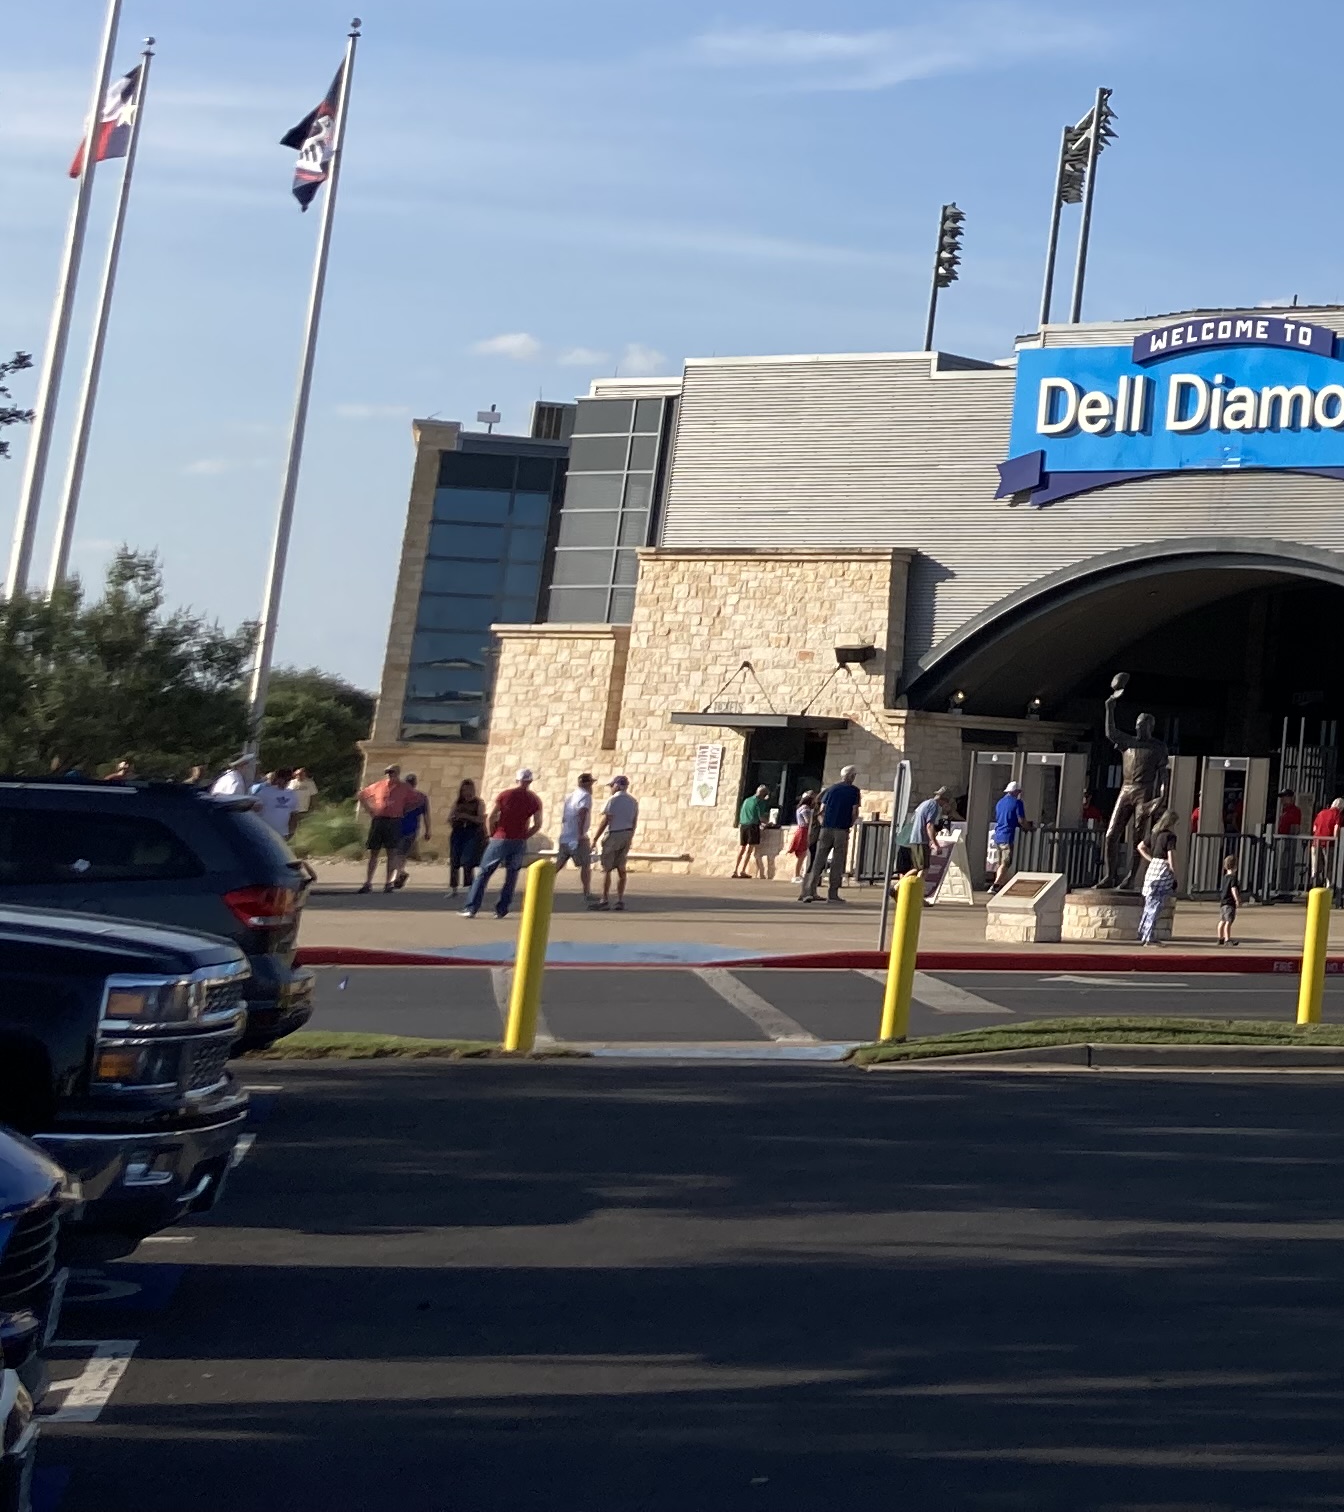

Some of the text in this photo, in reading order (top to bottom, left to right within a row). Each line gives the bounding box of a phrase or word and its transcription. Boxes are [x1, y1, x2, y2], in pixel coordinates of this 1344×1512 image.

[1150, 320, 1313, 352] WELCOME TO
[1036, 375, 1143, 435] Dell
[1273, 961, 1294, 972] FIRE
